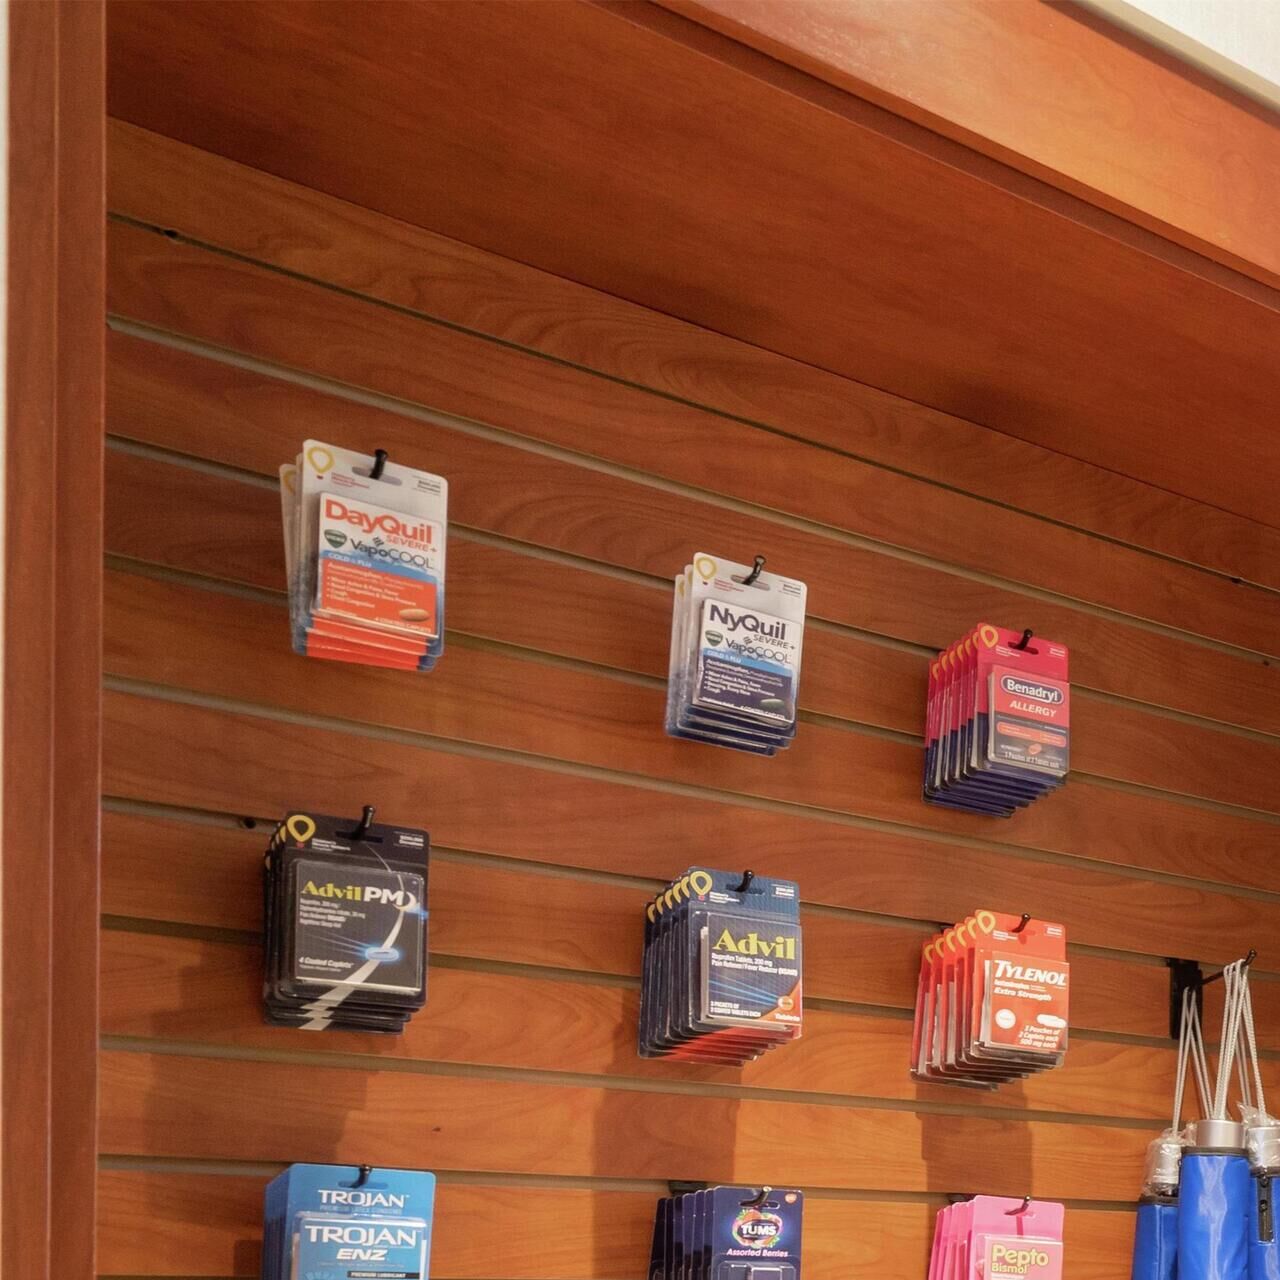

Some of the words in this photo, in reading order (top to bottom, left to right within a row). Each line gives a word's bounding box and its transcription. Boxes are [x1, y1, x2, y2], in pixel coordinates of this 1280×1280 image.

[325, 498, 433, 545] DayQuil
[350, 538, 435, 569] VapoCOOL
[710, 604, 786, 640] NyQuil
[725, 637, 791, 664] VapoCOOL
[1006, 678, 1059, 703] Benadryl
[1010, 700, 1057, 717] ALLERGY
[302, 880, 361, 901] Advil
[364, 886, 405, 905] PM
[713, 927, 796, 961] Advil
[994, 960, 1067, 987] TYLENOL
[1017, 989, 1053, 1002] Strength
[318, 1189, 405, 1209] TROJAN
[304, 1225, 417, 1248] TROJAN
[741, 1224, 778, 1237] TUMS
[336, 1248, 389, 1262] ENZ
[726, 1248, 761, 1257] Assorted
[762, 1249, 789, 1258] Berries
[991, 1244, 1050, 1268] Pepto
[991, 1262, 1028, 1275] Bismol
